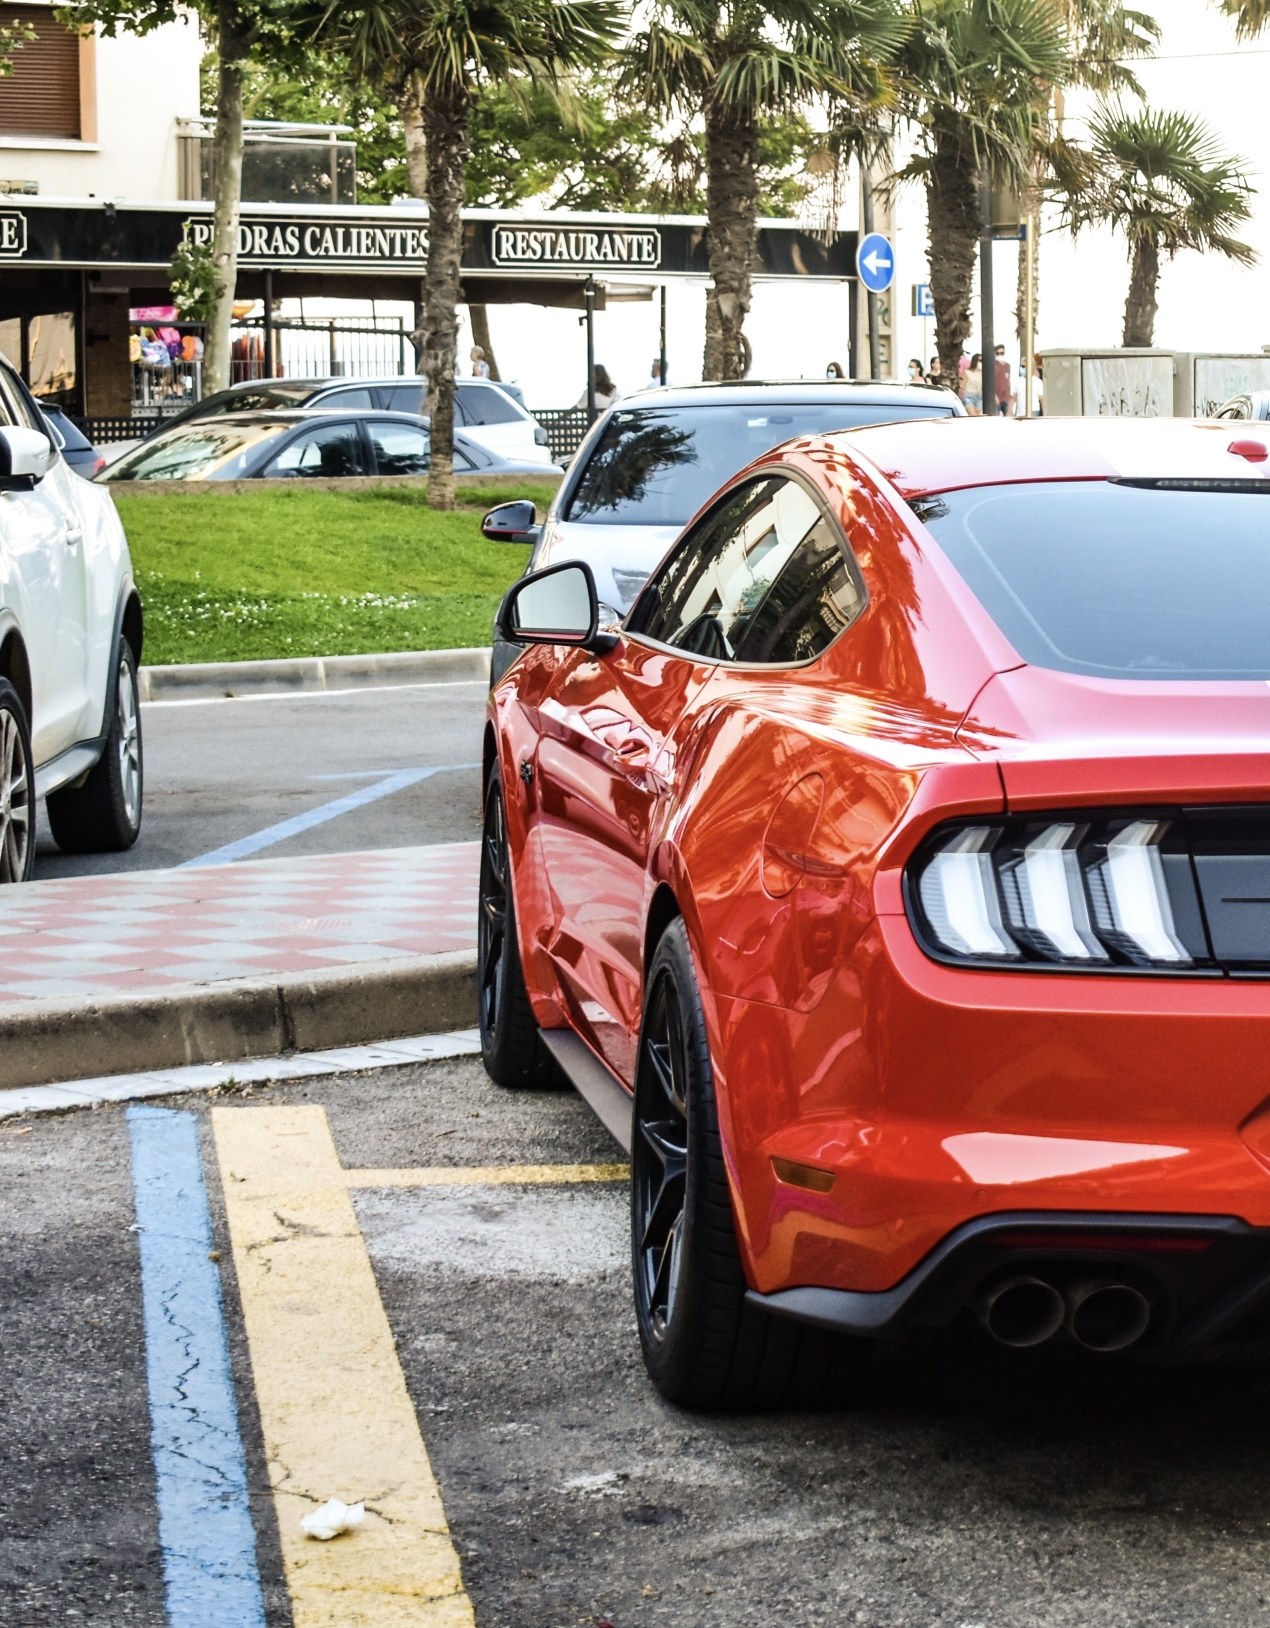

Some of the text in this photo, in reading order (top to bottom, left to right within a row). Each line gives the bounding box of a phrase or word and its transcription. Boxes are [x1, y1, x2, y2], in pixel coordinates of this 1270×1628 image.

[193, 223, 430, 259] PDRAS CALIENTES
[499, 230, 656, 262] RESTAURANTE
